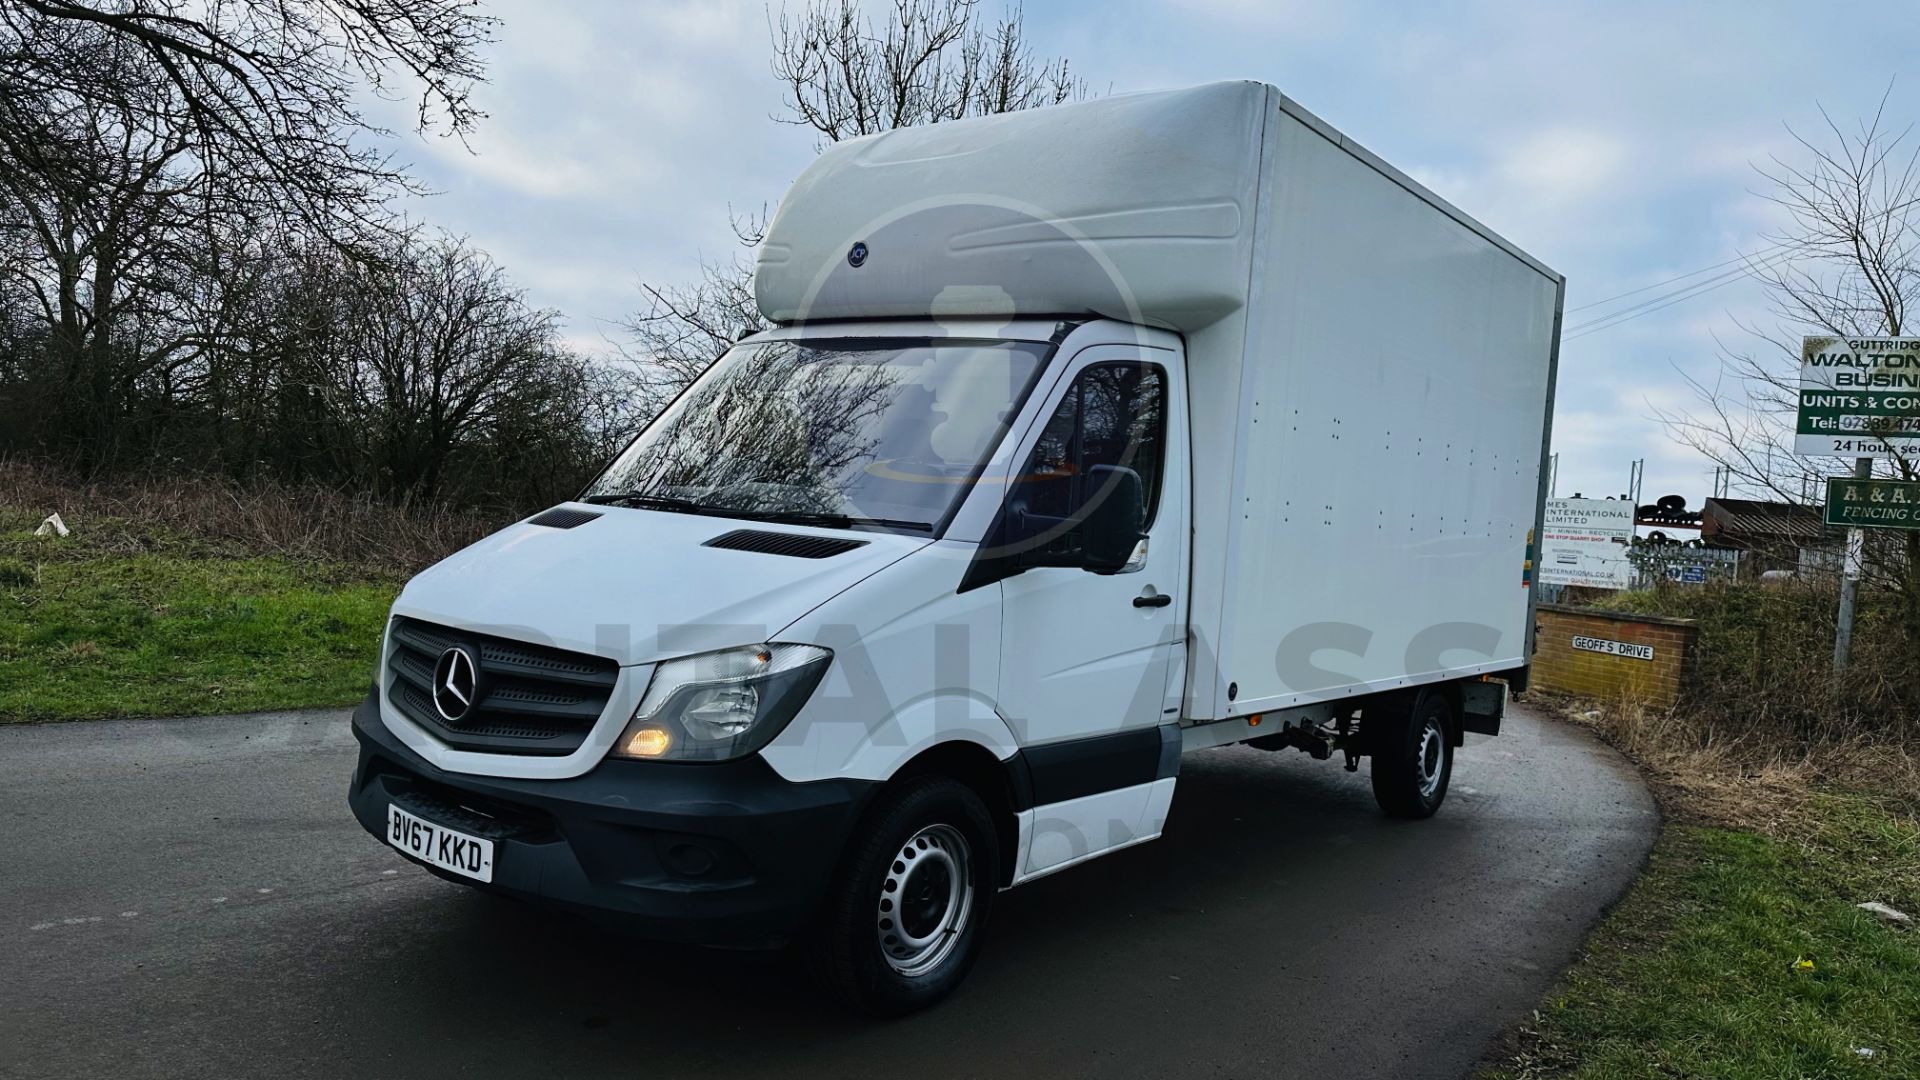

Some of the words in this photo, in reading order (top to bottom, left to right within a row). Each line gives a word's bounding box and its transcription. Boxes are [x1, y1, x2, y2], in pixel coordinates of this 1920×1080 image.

[1808, 353, 1920, 368] WALTON
[1836, 373, 1920, 388] BUSIN
[1803, 395, 1860, 408] UNITS
[1865, 397, 1878, 409] &
[1808, 416, 1837, 429] Tel:
[1833, 440, 1851, 452] 24
[1857, 440, 1895, 453] hour
[1900, 446, 1920, 454] se
[1843, 486, 1862, 501] A.
[1870, 487, 1885, 503] &
[1890, 488, 1911, 504] A.
[1547, 501, 1568, 509] MES
[1546, 509, 1630, 518] INTERNATIONAL
[1546, 516, 1588, 524] LIMITED
[1842, 506, 1909, 520] FENCING
[1619, 644, 1650, 658] DRIVE
[393, 810, 433, 856] BV67
[439, 831, 481, 872] KKD
